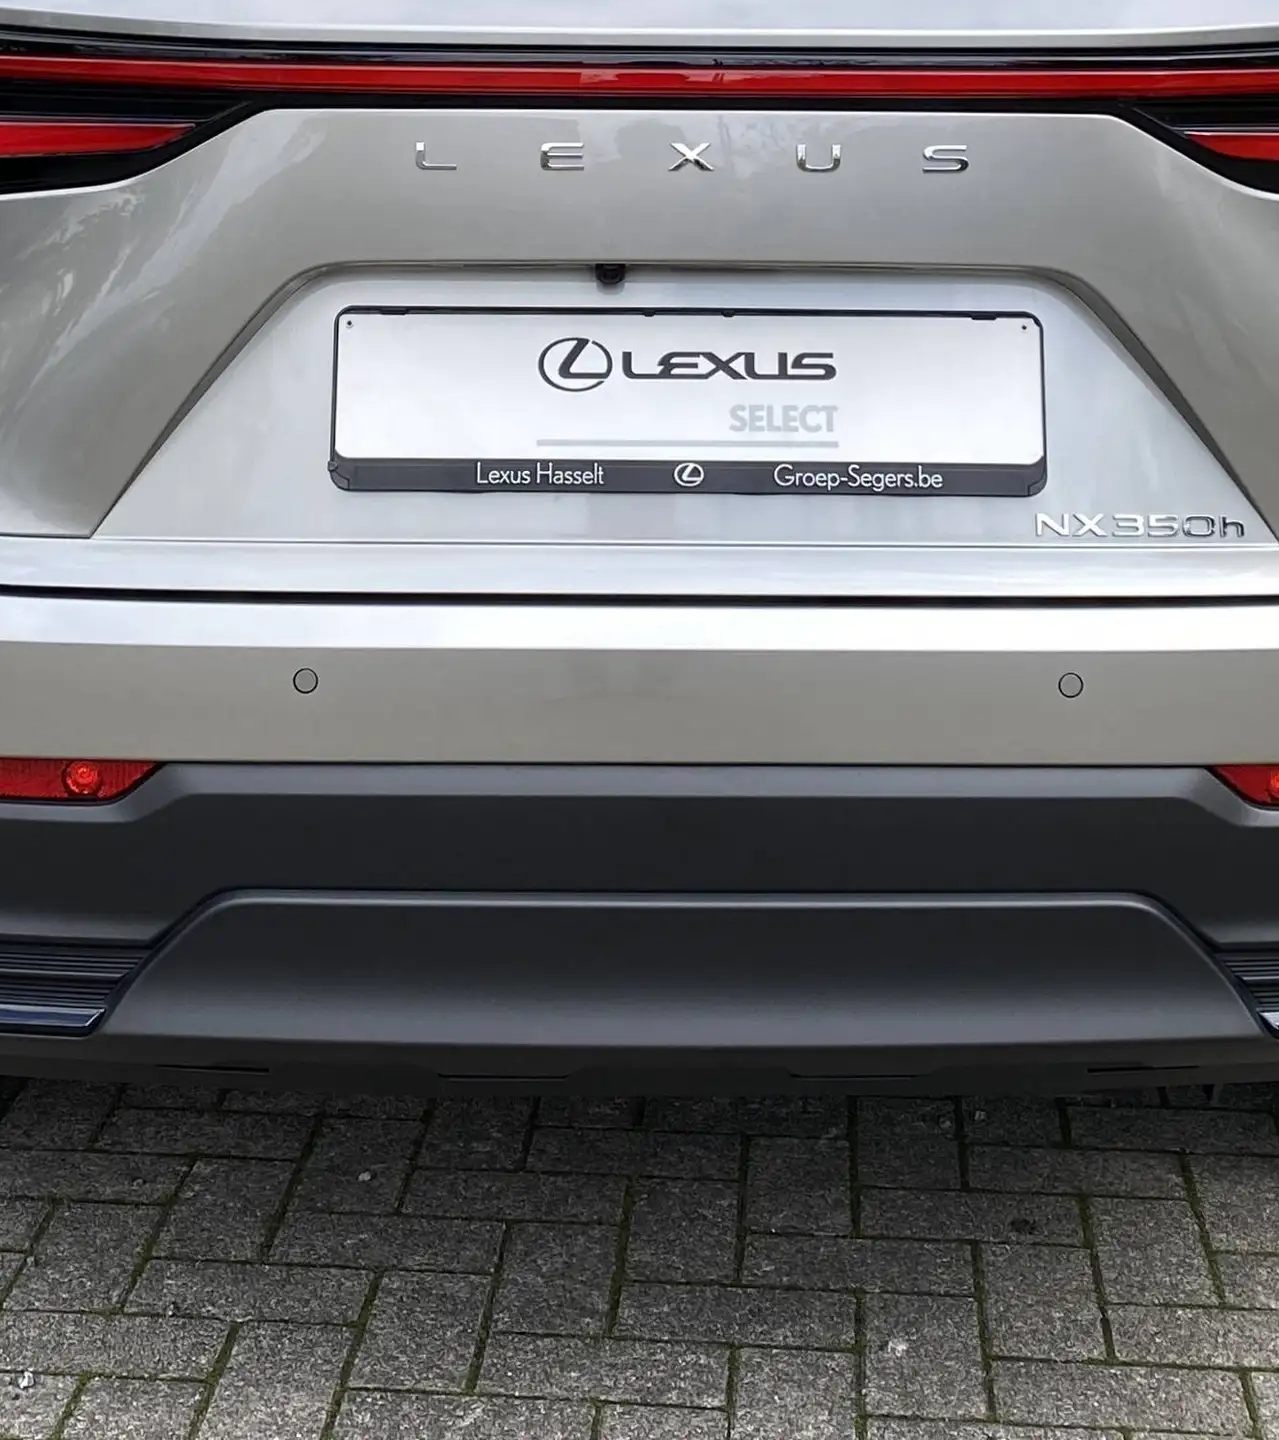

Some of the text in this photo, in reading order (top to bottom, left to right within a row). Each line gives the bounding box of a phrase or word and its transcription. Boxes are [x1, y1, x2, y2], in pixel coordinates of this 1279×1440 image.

[415, 141, 969, 173] LEXUS
[622, 351, 838, 380] LEXUS
[728, 404, 839, 433] SELECT
[476, 461, 605, 485] Lexus Hasselt
[773, 463, 943, 492] Groep-Segers.be
